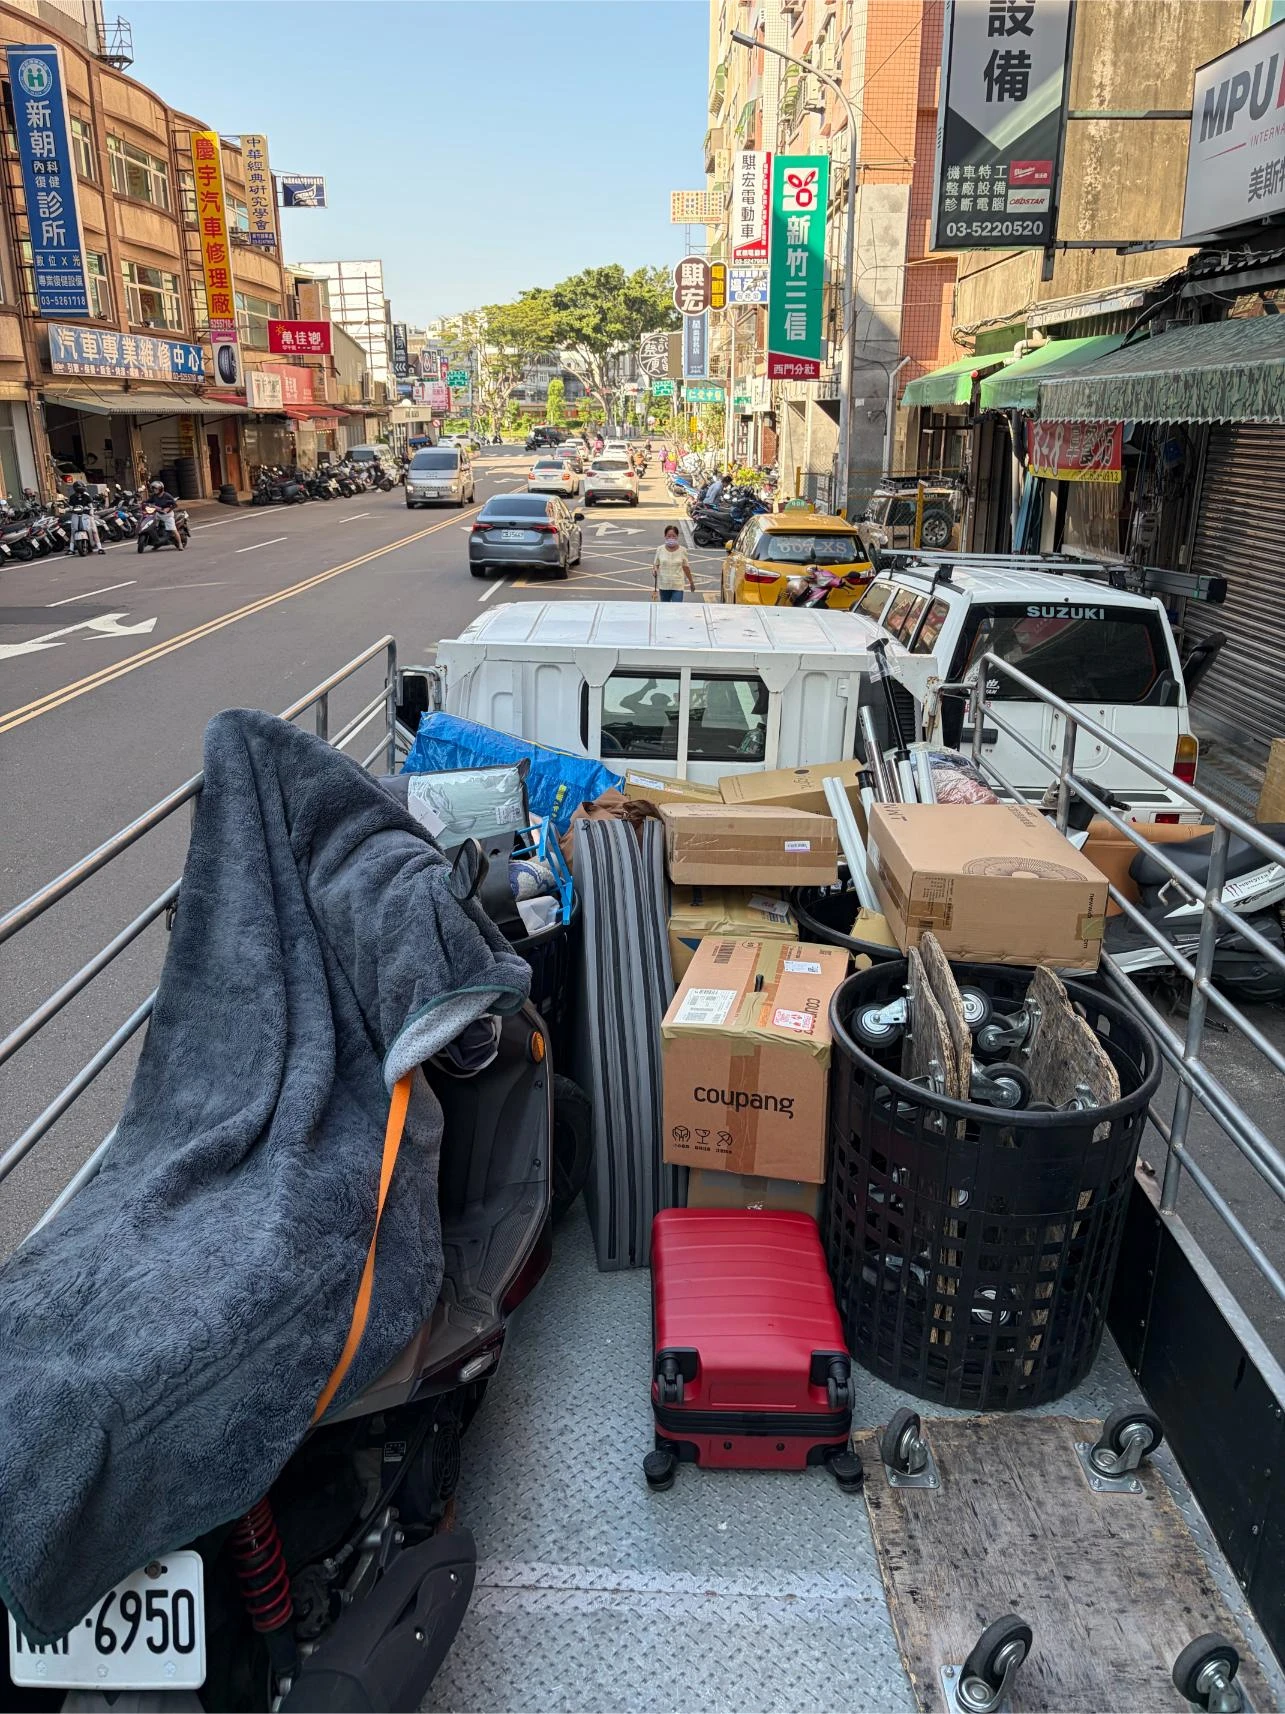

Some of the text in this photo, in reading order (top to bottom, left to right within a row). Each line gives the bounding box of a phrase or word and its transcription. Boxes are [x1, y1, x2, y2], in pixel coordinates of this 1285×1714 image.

[983, 0, 1034, 103] 設備
[25, 100, 56, 157] 新朝
[33, 160, 58, 174] 內科
[35, 176, 61, 188] 復健
[246, 137, 270, 231] 中華經典研究學會
[946, 164, 1008, 180] 機車特工
[741, 153, 756, 238] 騏宏電動車
[944, 197, 1005, 212] 診斷電腦
[945, 181, 1007, 196] 整廠設備
[36, 190, 66, 247] 診所
[195, 138, 232, 314] 慶宇汽車修理廠
[946, 220, 1044, 237] 03-5220520
[681, 263, 704, 311] 騏宏
[711, 265, 725, 307] 電動車
[784, 214, 810, 341] 新竹三信
[57, 328, 200, 371] 汽車專業維修中心
[281, 330, 321, 345] 萬佳鄉
[773, 363, 815, 375] 西門分社
[1027, 605, 1105, 620] SUZUKI
[694, 1086, 795, 1119] coupang
